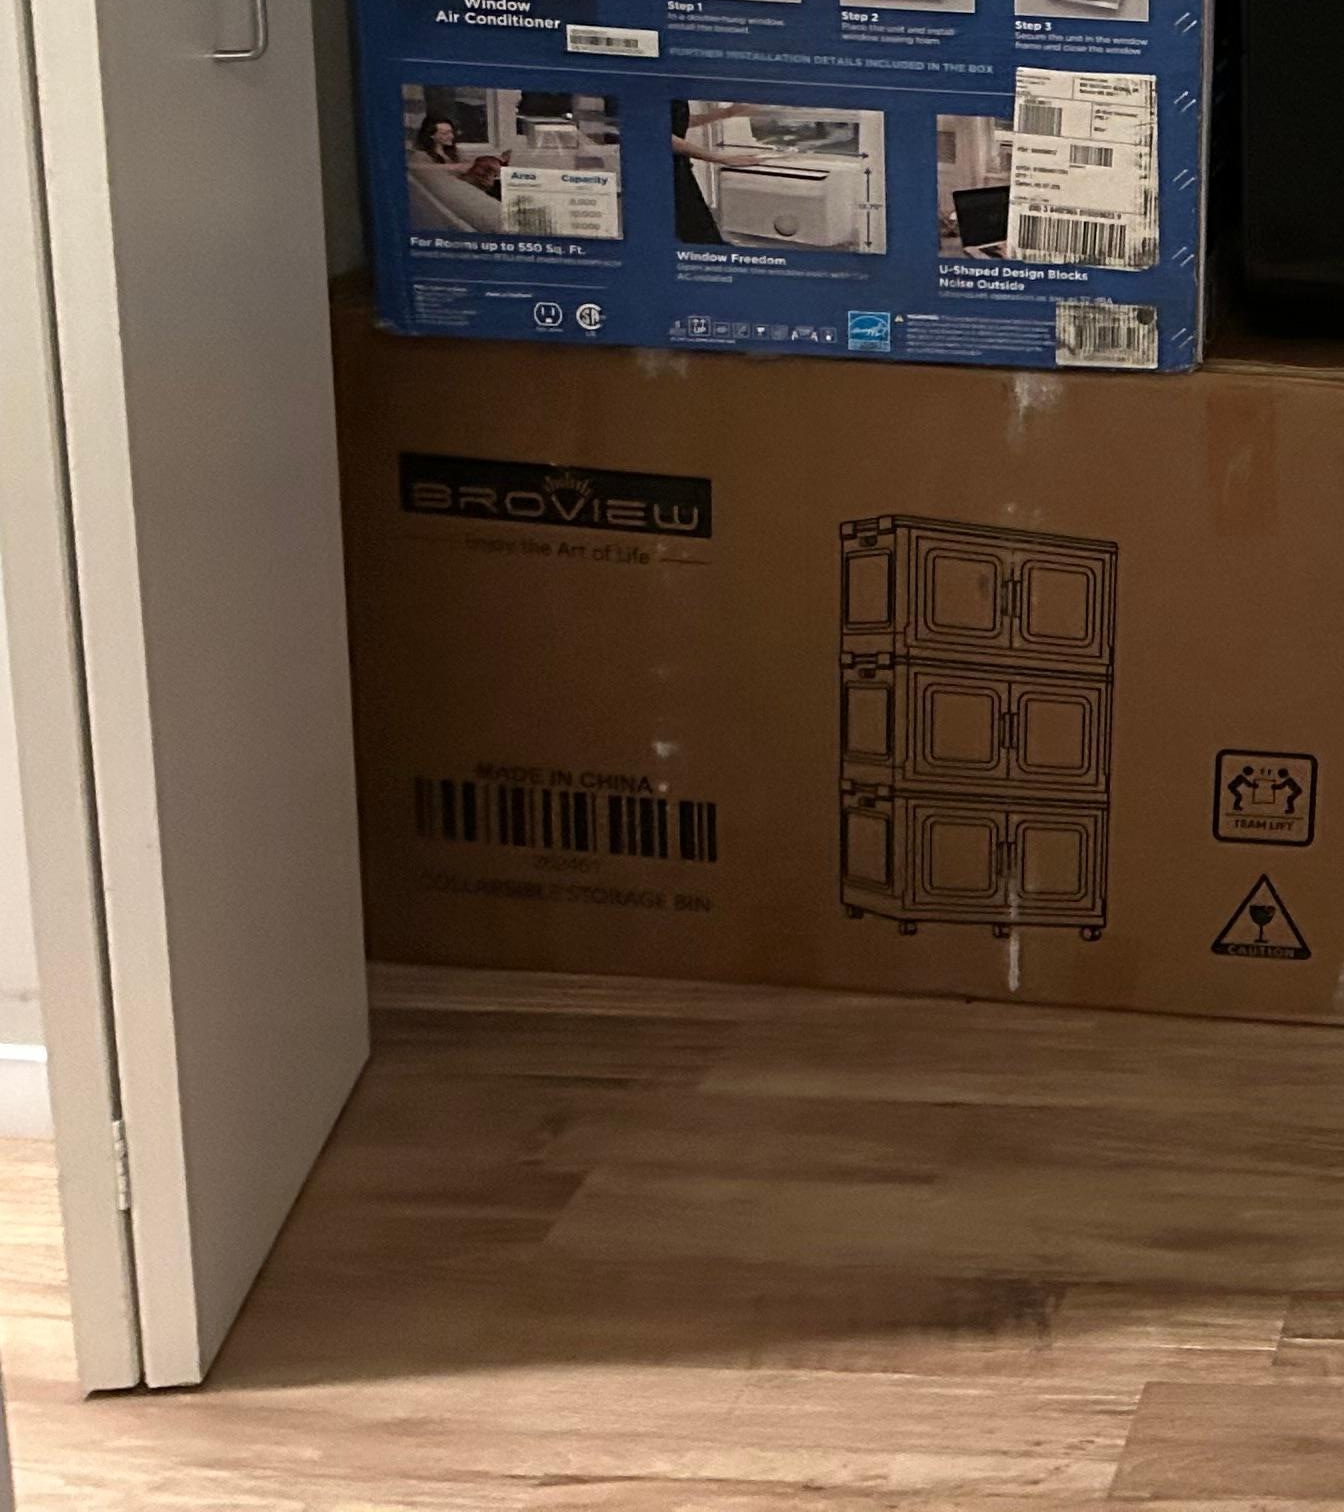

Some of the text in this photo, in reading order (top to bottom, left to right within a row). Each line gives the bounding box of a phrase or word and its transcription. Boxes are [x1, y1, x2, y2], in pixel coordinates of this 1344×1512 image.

[667, 0, 703, 13] Step 1
[435, 9, 562, 30] Air Conditioner
[841, 11, 880, 22] Step 2
[1014, 20, 1053, 32] Step 3
[1112, 37, 1149, 46] window
[1105, 46, 1142, 55] window
[726, 50, 811, 65] INSTALLATION
[813, 55, 863, 68] DETAILS
[864, 58, 926, 71] INCLUDED
[927, 62, 941, 72] IN
[942, 62, 966, 73] THE
[967, 64, 994, 74] BOX
[510, 171, 608, 186] Area Capacity
[410, 236, 433, 249] For
[434, 238, 479, 251] Rooms
[481, 241, 498, 253] up
[500, 241, 515, 252] to
[569, 244, 587, 255] Ft.
[676, 250, 787, 266] Window Freedom
[938, 264, 1089, 282] U-Shaped Design Blocks
[939, 278, 1025, 291] Noise Outside
[412, 480, 700, 532] BROVIEW
[520, 538, 552, 555] the
[557, 541, 586, 558] Art
[592, 545, 611, 561] of
[617, 546, 650, 565] Life
[475, 761, 653, 794] MADE IN CHINA
[1234, 818, 1295, 832] TEAM LIFT
[673, 893, 712, 913] BIN
[1226, 944, 1297, 959] CAUTION
